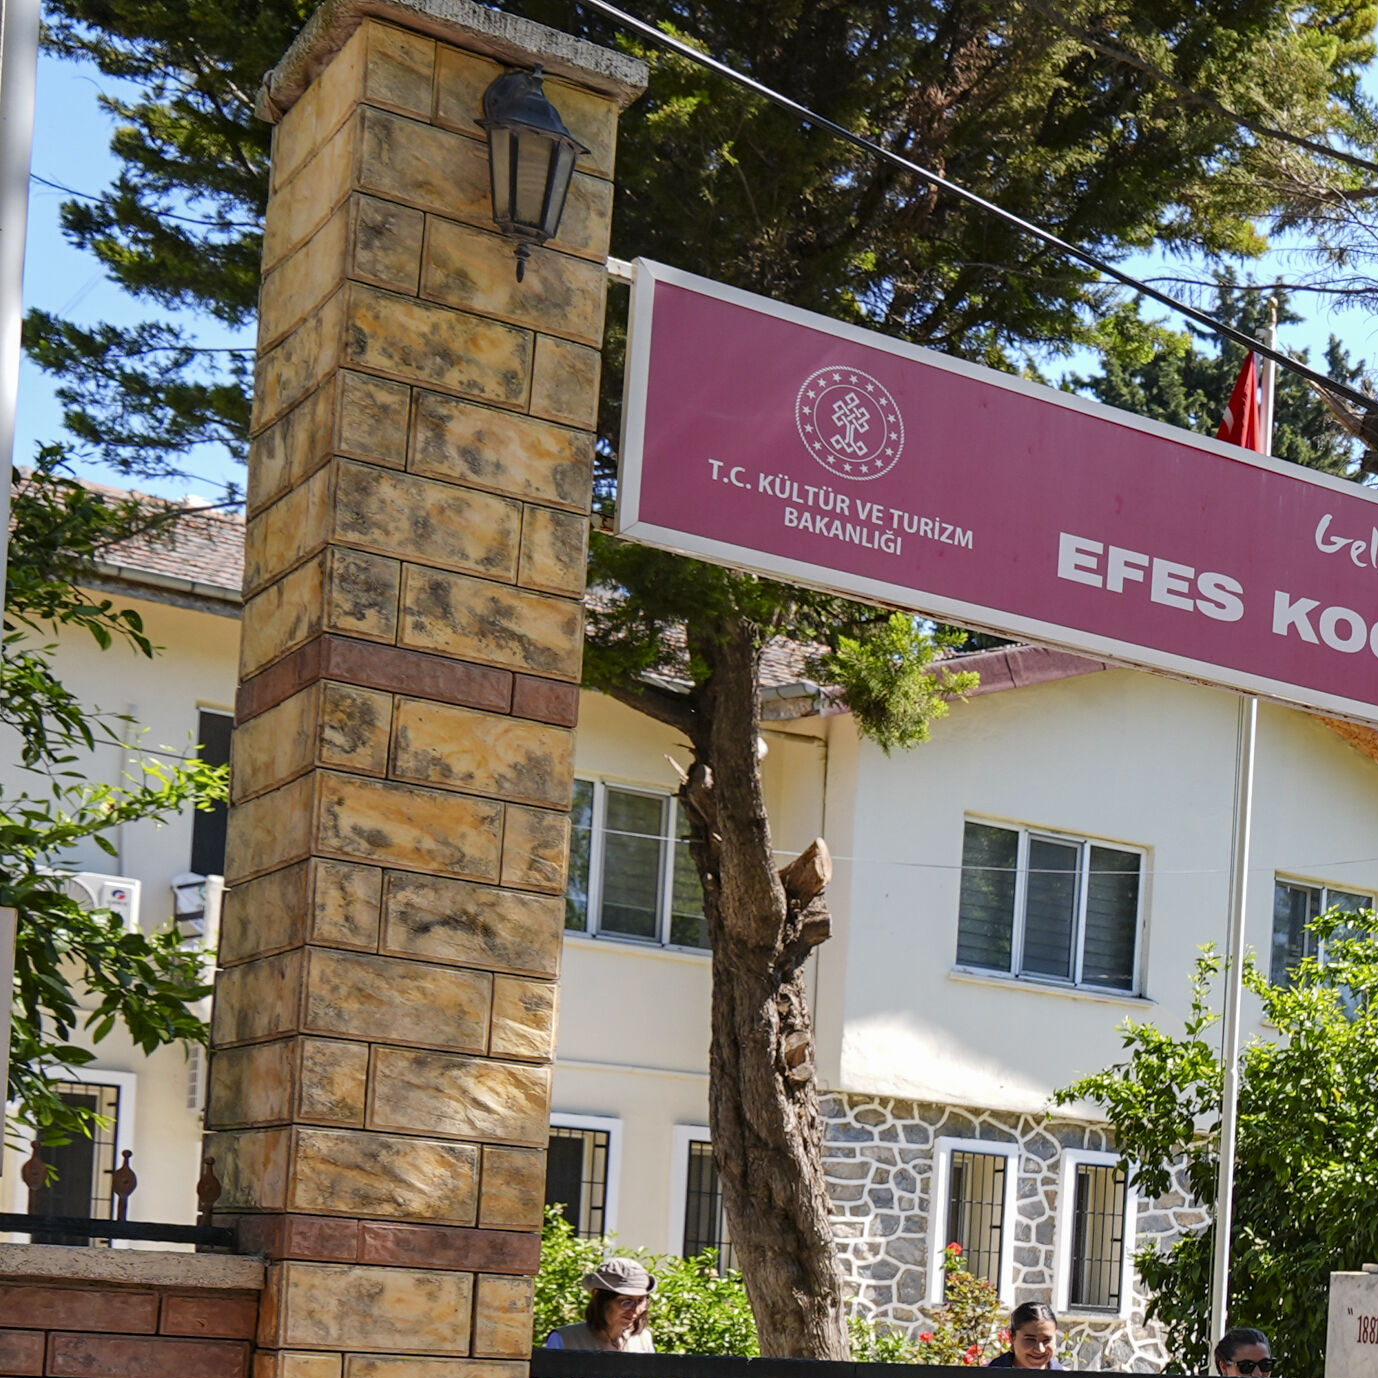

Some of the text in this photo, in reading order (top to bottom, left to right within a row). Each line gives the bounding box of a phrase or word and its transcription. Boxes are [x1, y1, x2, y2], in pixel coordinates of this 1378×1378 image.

[708, 458, 974, 550] T.C. KÜLTÜR VE TURİZM
[783, 506, 903, 556] BAKANLIĞI
[1057, 531, 1245, 622] EFES
